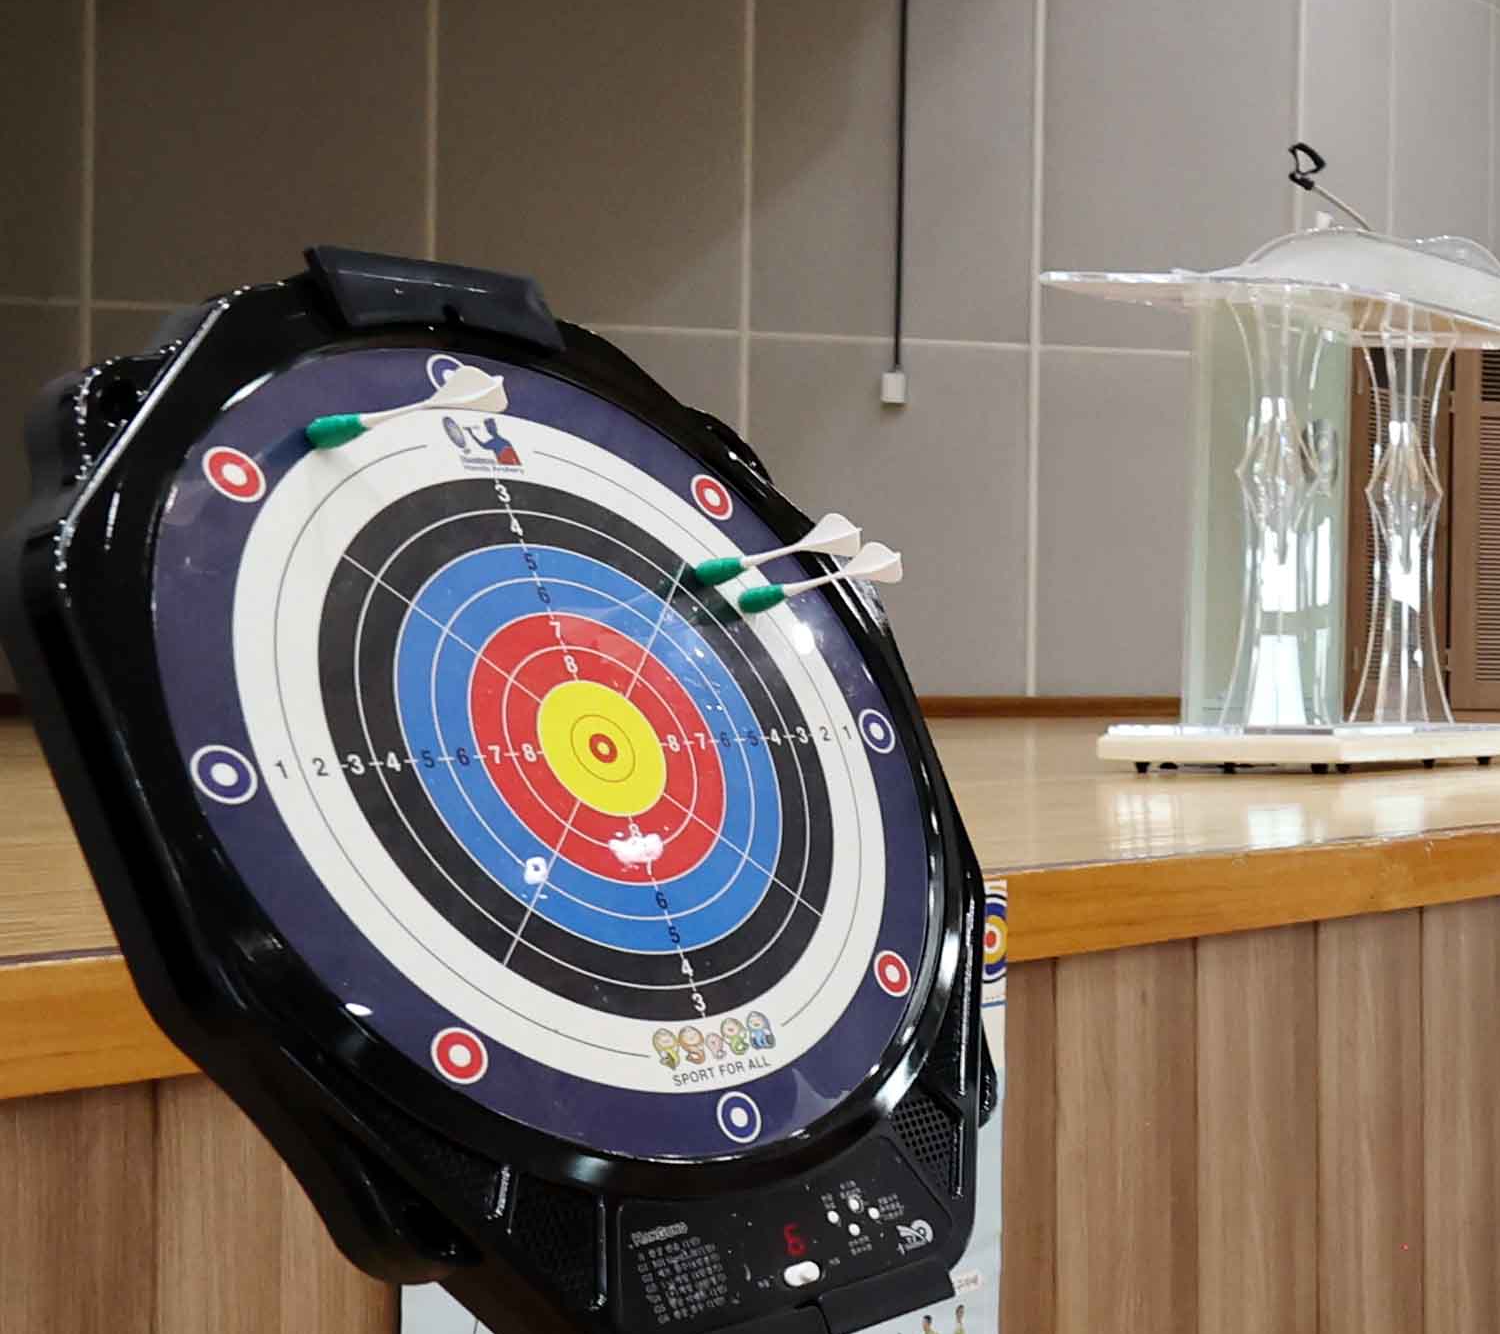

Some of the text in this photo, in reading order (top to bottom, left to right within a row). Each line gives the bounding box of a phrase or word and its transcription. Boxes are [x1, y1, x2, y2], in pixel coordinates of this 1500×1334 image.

[494, 484, 578, 674] 3 4 5 6 7 8
[276, 725, 852, 779] 1 2 3 4 5 6 7 8 8 7 6 5 4 3 2 1
[655, 891, 706, 1011] 6 5 4 3
[672, 1055, 772, 1087] SPORT FOR ALL
